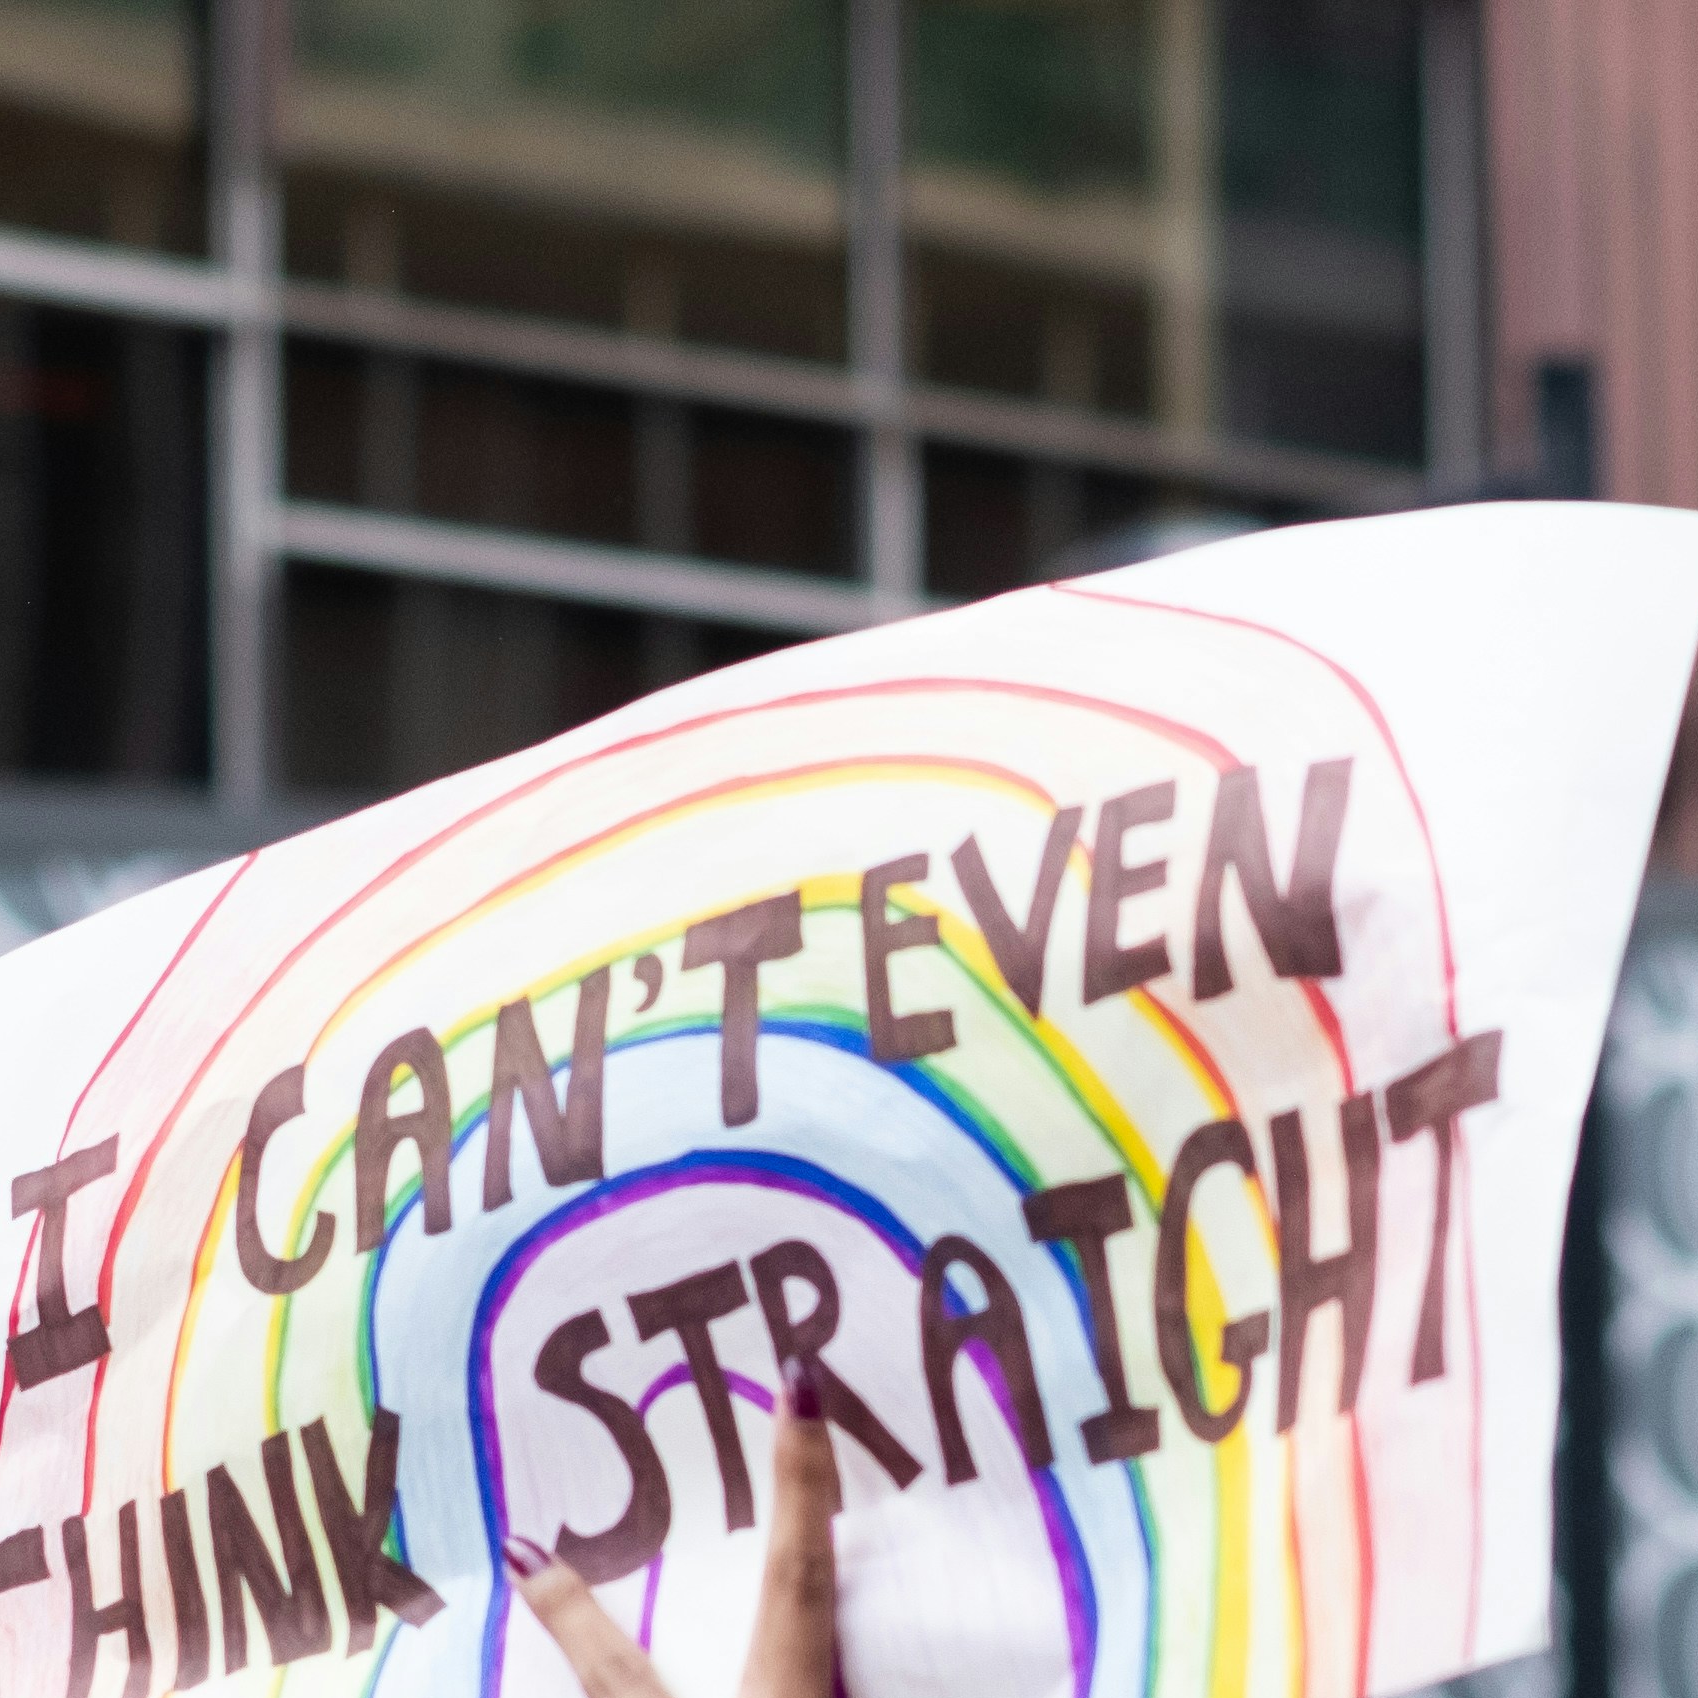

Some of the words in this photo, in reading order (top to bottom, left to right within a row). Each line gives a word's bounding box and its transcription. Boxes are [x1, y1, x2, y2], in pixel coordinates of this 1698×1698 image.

[7, 1132, 119, 1392] I
[234, 889, 803, 1295] CAN'T
[860, 756, 1354, 1062] EVEN
[534, 1028, 1505, 1587] STRAIGHT
